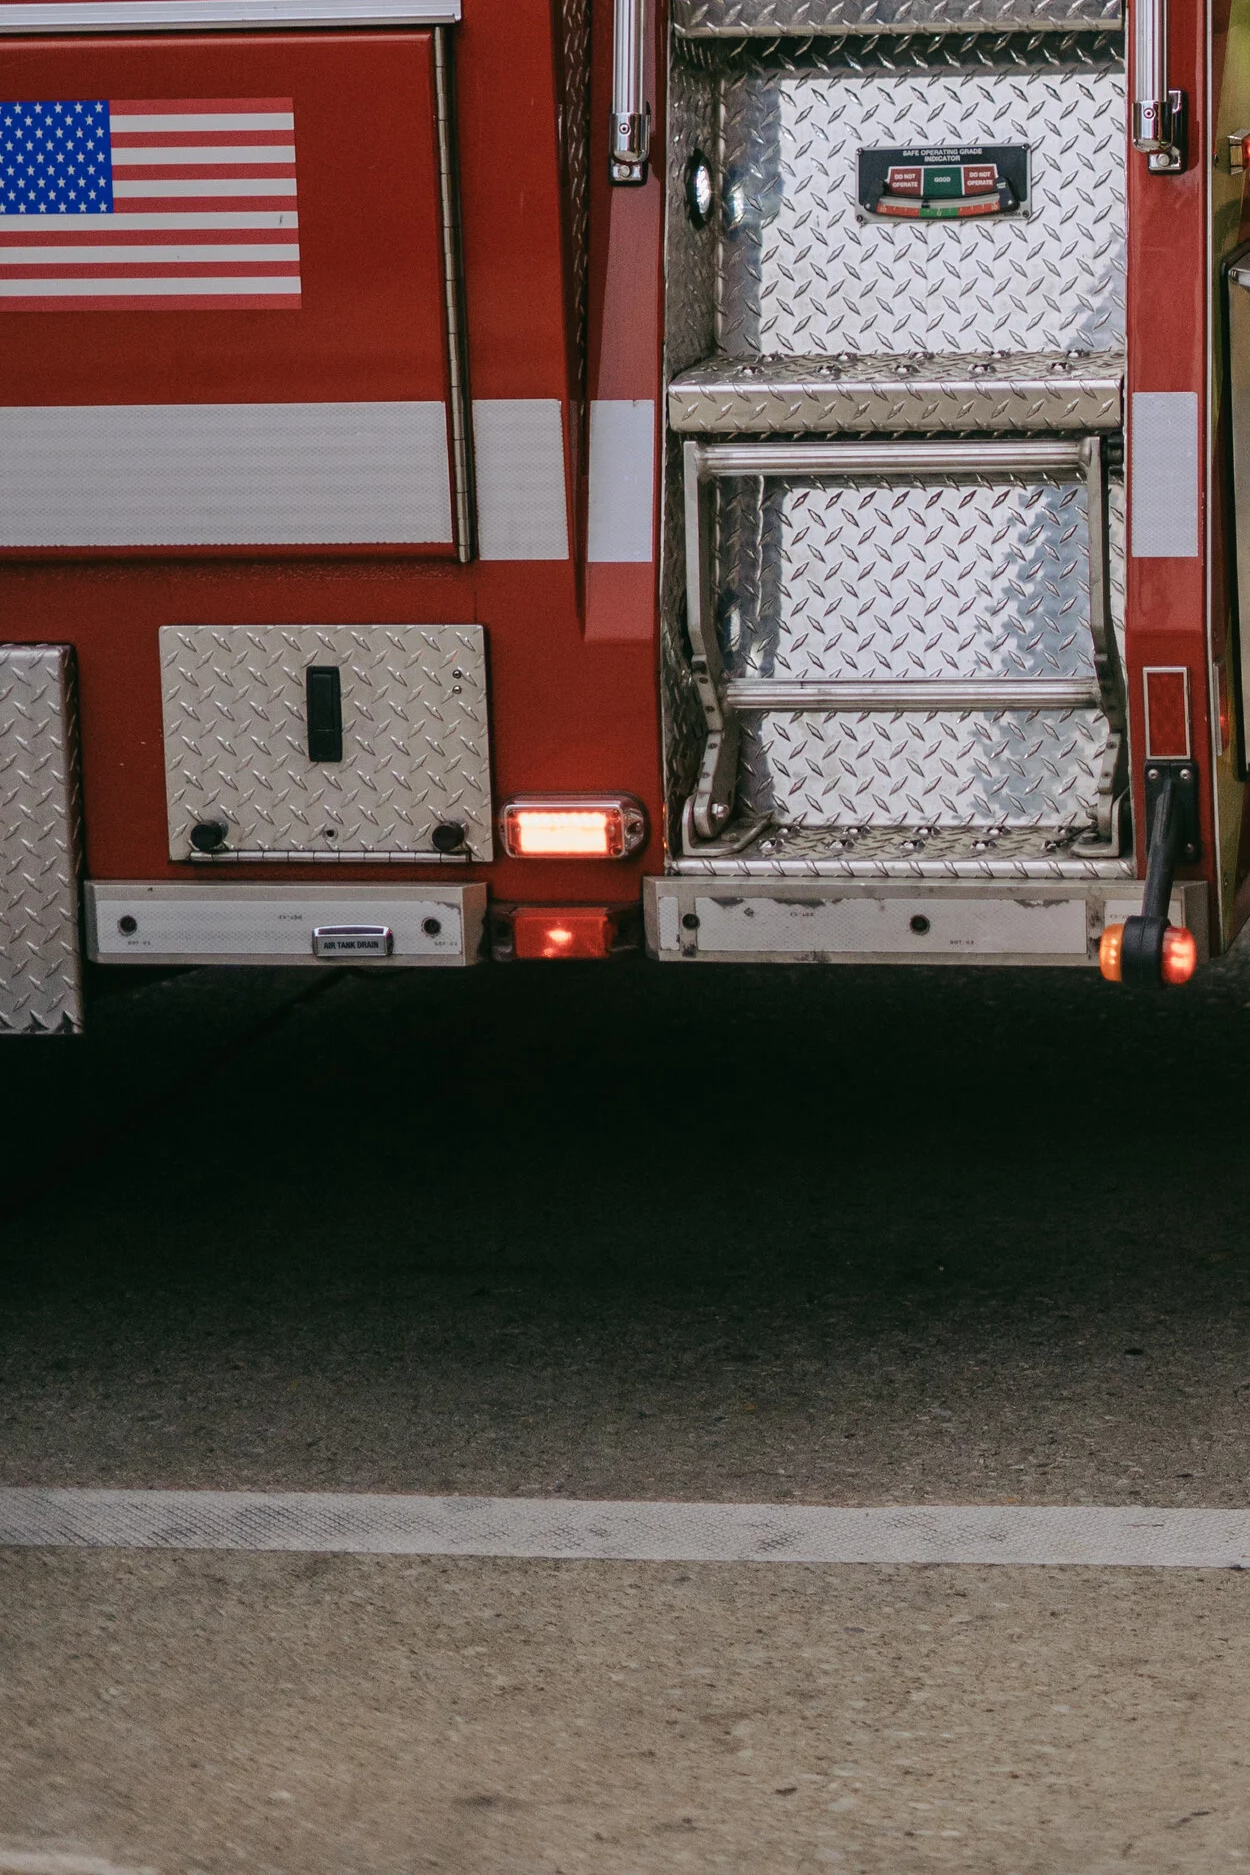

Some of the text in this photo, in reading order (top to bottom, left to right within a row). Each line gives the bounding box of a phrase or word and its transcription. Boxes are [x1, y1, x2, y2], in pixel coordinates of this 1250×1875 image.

[920, 148, 959, 156] OPERATING
[323, 940, 379, 949] AIR TANK DRAIN
